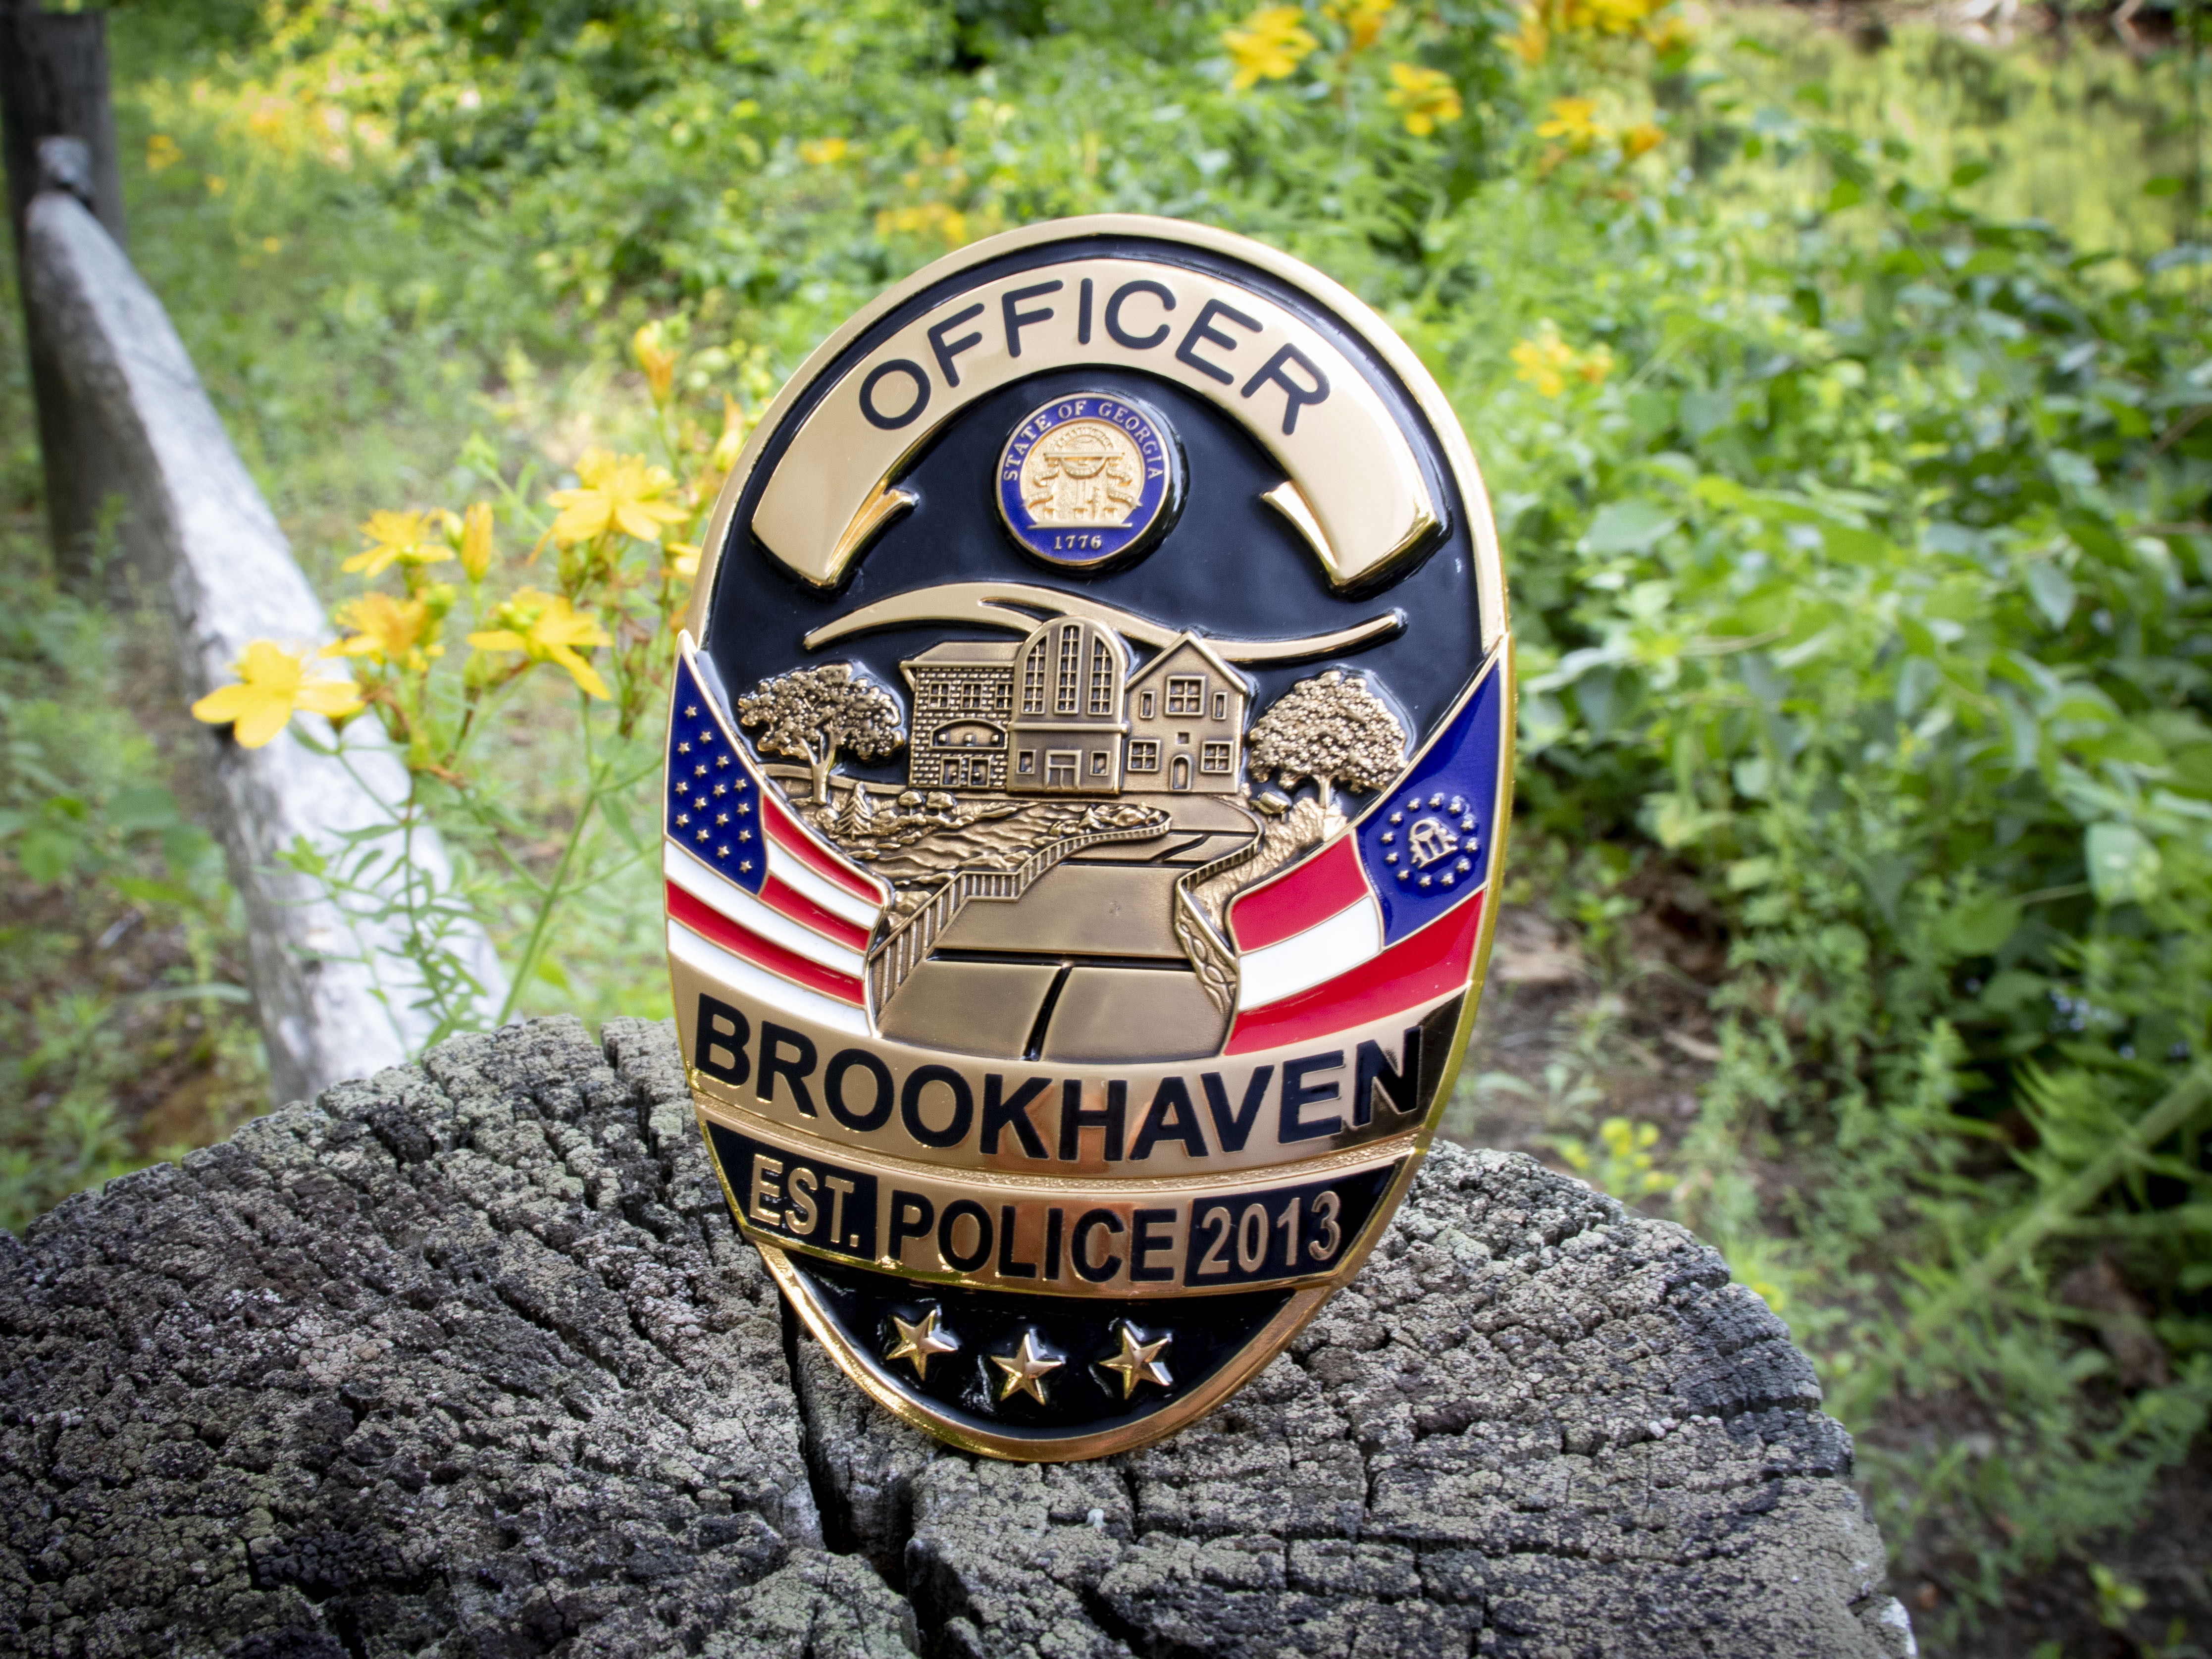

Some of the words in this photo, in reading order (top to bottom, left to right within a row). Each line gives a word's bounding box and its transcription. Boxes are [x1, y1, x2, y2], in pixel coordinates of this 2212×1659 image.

[860, 278, 1331, 435] OFFICER
[1004, 415, 1051, 480] STATE
[1058, 400, 1087, 418] OF
[1098, 402, 1164, 479] GEORGIA
[1053, 535, 1103, 550] 1776
[695, 993, 1422, 1161] BROOKHAVEN
[750, 1154, 859, 1248] EST.
[889, 1190, 1177, 1282] POLICE
[1197, 1191, 1341, 1275] 2013
